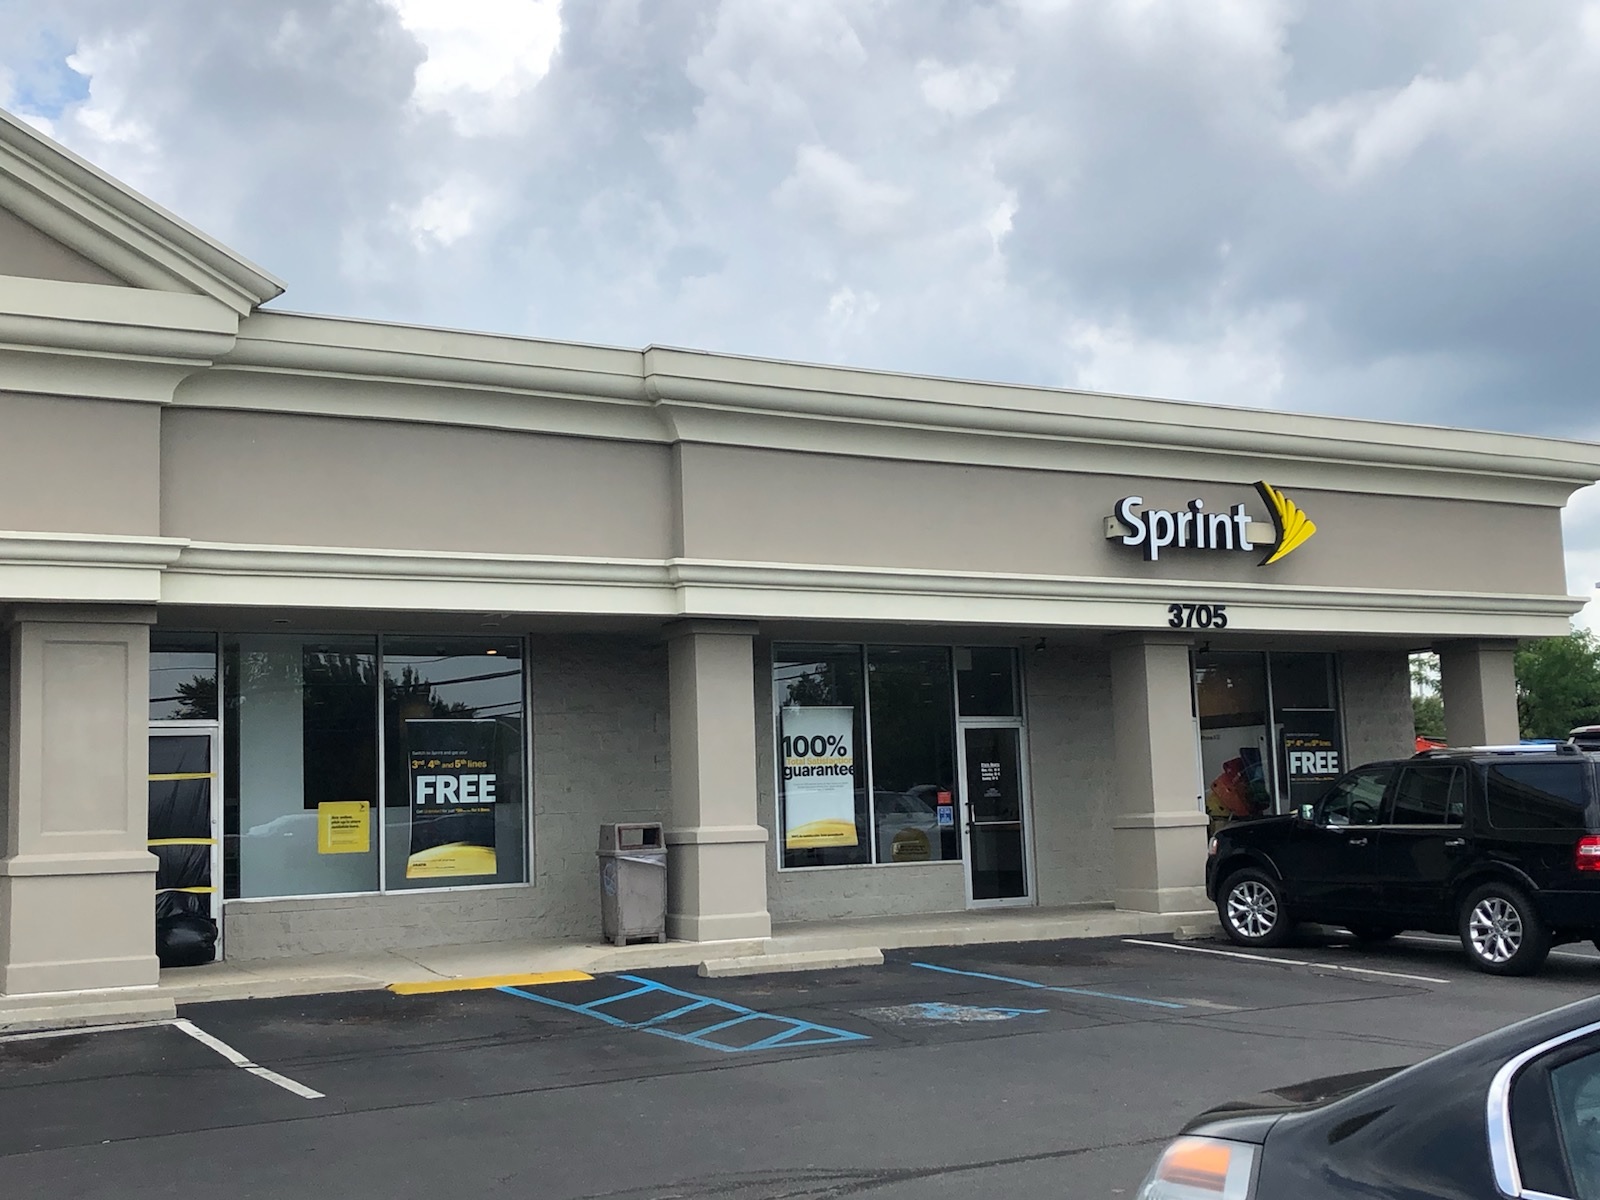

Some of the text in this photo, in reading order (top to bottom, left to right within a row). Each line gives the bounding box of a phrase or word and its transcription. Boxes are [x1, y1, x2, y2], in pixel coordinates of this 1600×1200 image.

[1115, 496, 1253, 561] Sprint
[1168, 603, 1228, 629] 3705
[782, 735, 847, 758] 100%
[454, 758, 467, 769] 5th
[467, 759, 487, 768] lines
[782, 764, 855, 780] guarantee
[787, 757, 805, 765] Total
[1290, 751, 1339, 774] FREE
[416, 774, 496, 804] FREE
